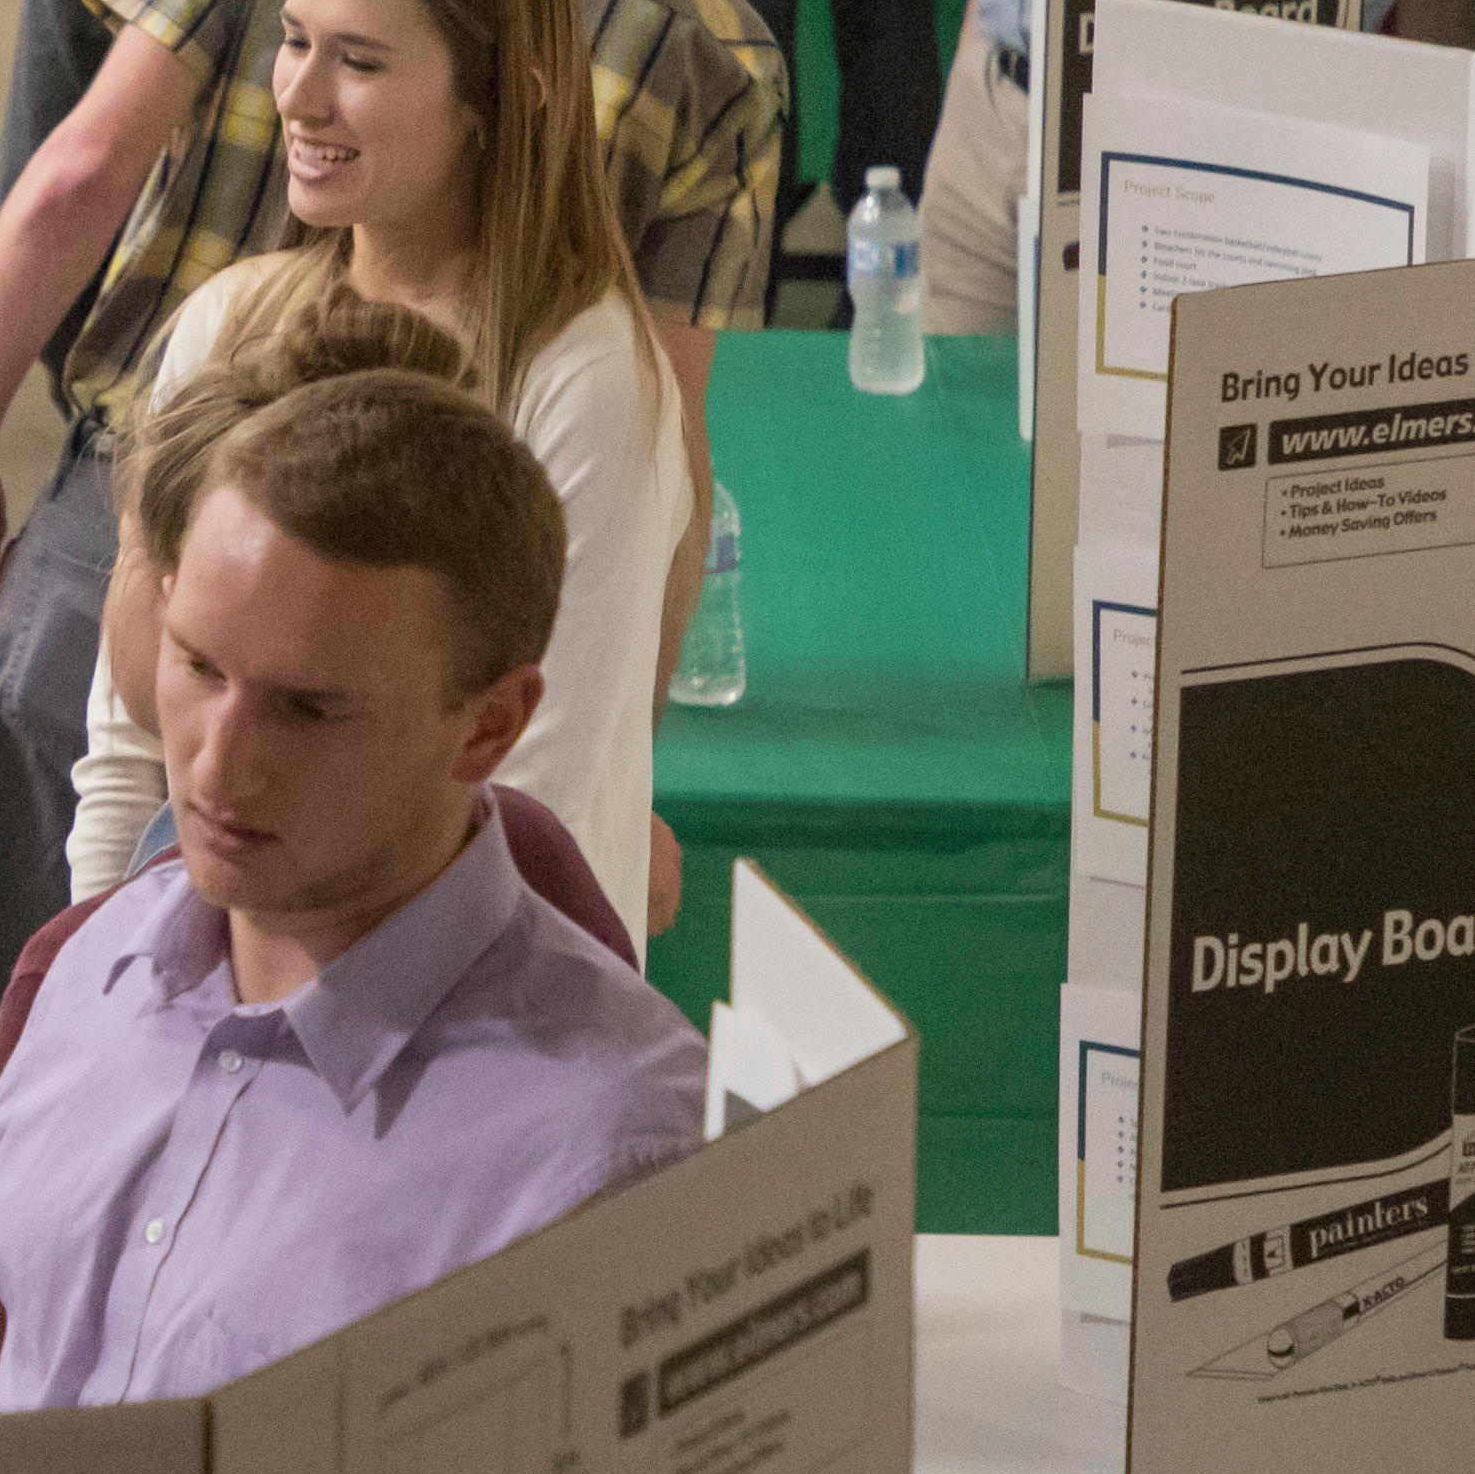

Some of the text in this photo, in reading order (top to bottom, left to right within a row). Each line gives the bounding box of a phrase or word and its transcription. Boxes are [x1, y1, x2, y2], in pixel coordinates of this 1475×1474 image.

[1123, 179, 1216, 205] Project Scope
[1221, 352, 1469, 402] Bring Your Ideas
[1290, 476, 1385, 498] Project Ideas
[1289, 489, 1447, 520] Tips & How-To Videos
[1288, 510, 1437, 540] Money Saving Offers
[1192, 924, 1373, 994] Display
[1308, 1194, 1429, 1259] painters
